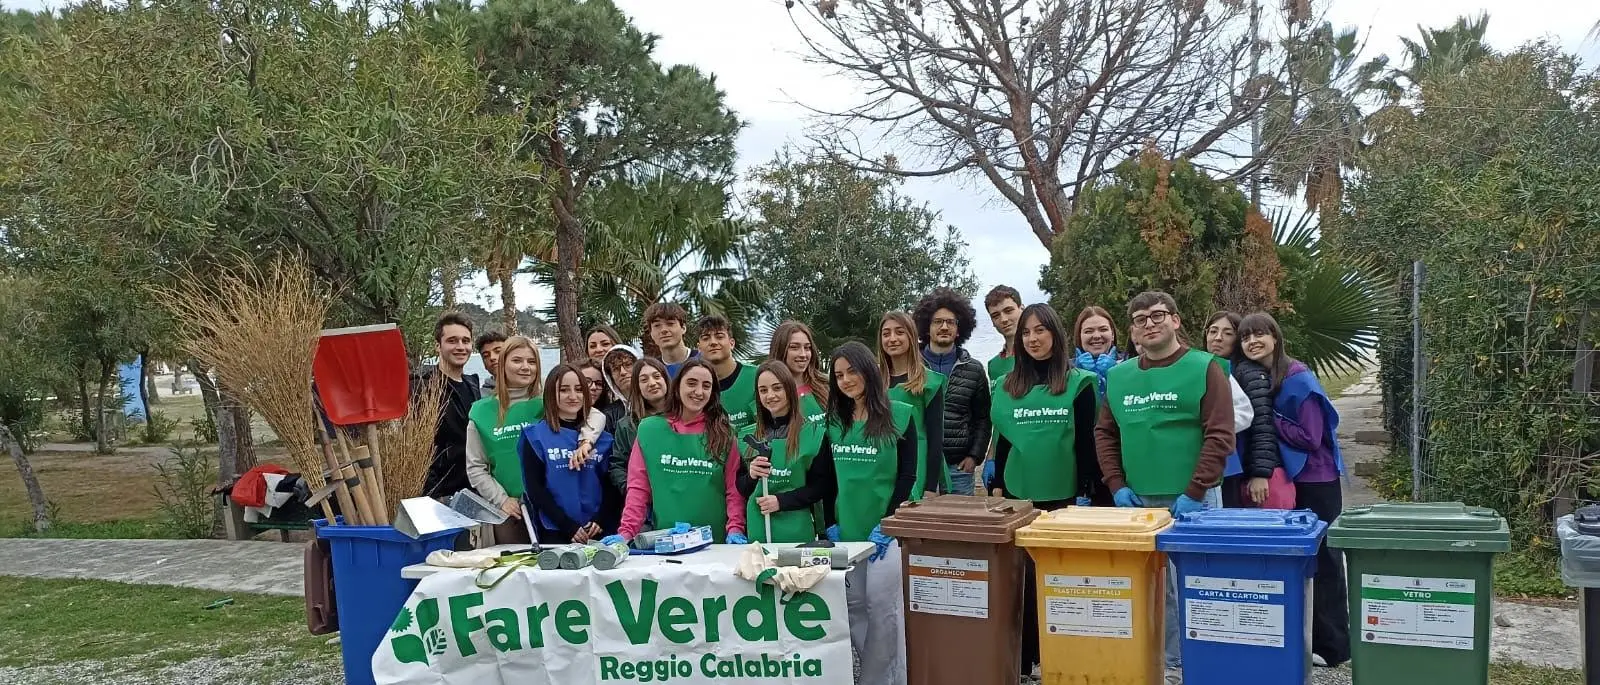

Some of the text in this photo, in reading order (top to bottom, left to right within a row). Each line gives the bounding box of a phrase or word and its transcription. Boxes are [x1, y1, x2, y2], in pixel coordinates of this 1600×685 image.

[1150, 392, 1178, 401] Verde
[808, 412, 826, 422] Ver
[1024, 408, 1068, 417] Fare Verde
[851, 444, 878, 454] Verde
[688, 458, 712, 468] Verde
[930, 568, 966, 577] ORGANICO
[1053, 587, 1086, 596] PLASTICA
[1198, 590, 1224, 598] CARTA
[1232, 592, 1270, 600] CARTONE
[448, 568, 833, 658] Fare Verde
[600, 652, 822, 682] Reggio Calabria
